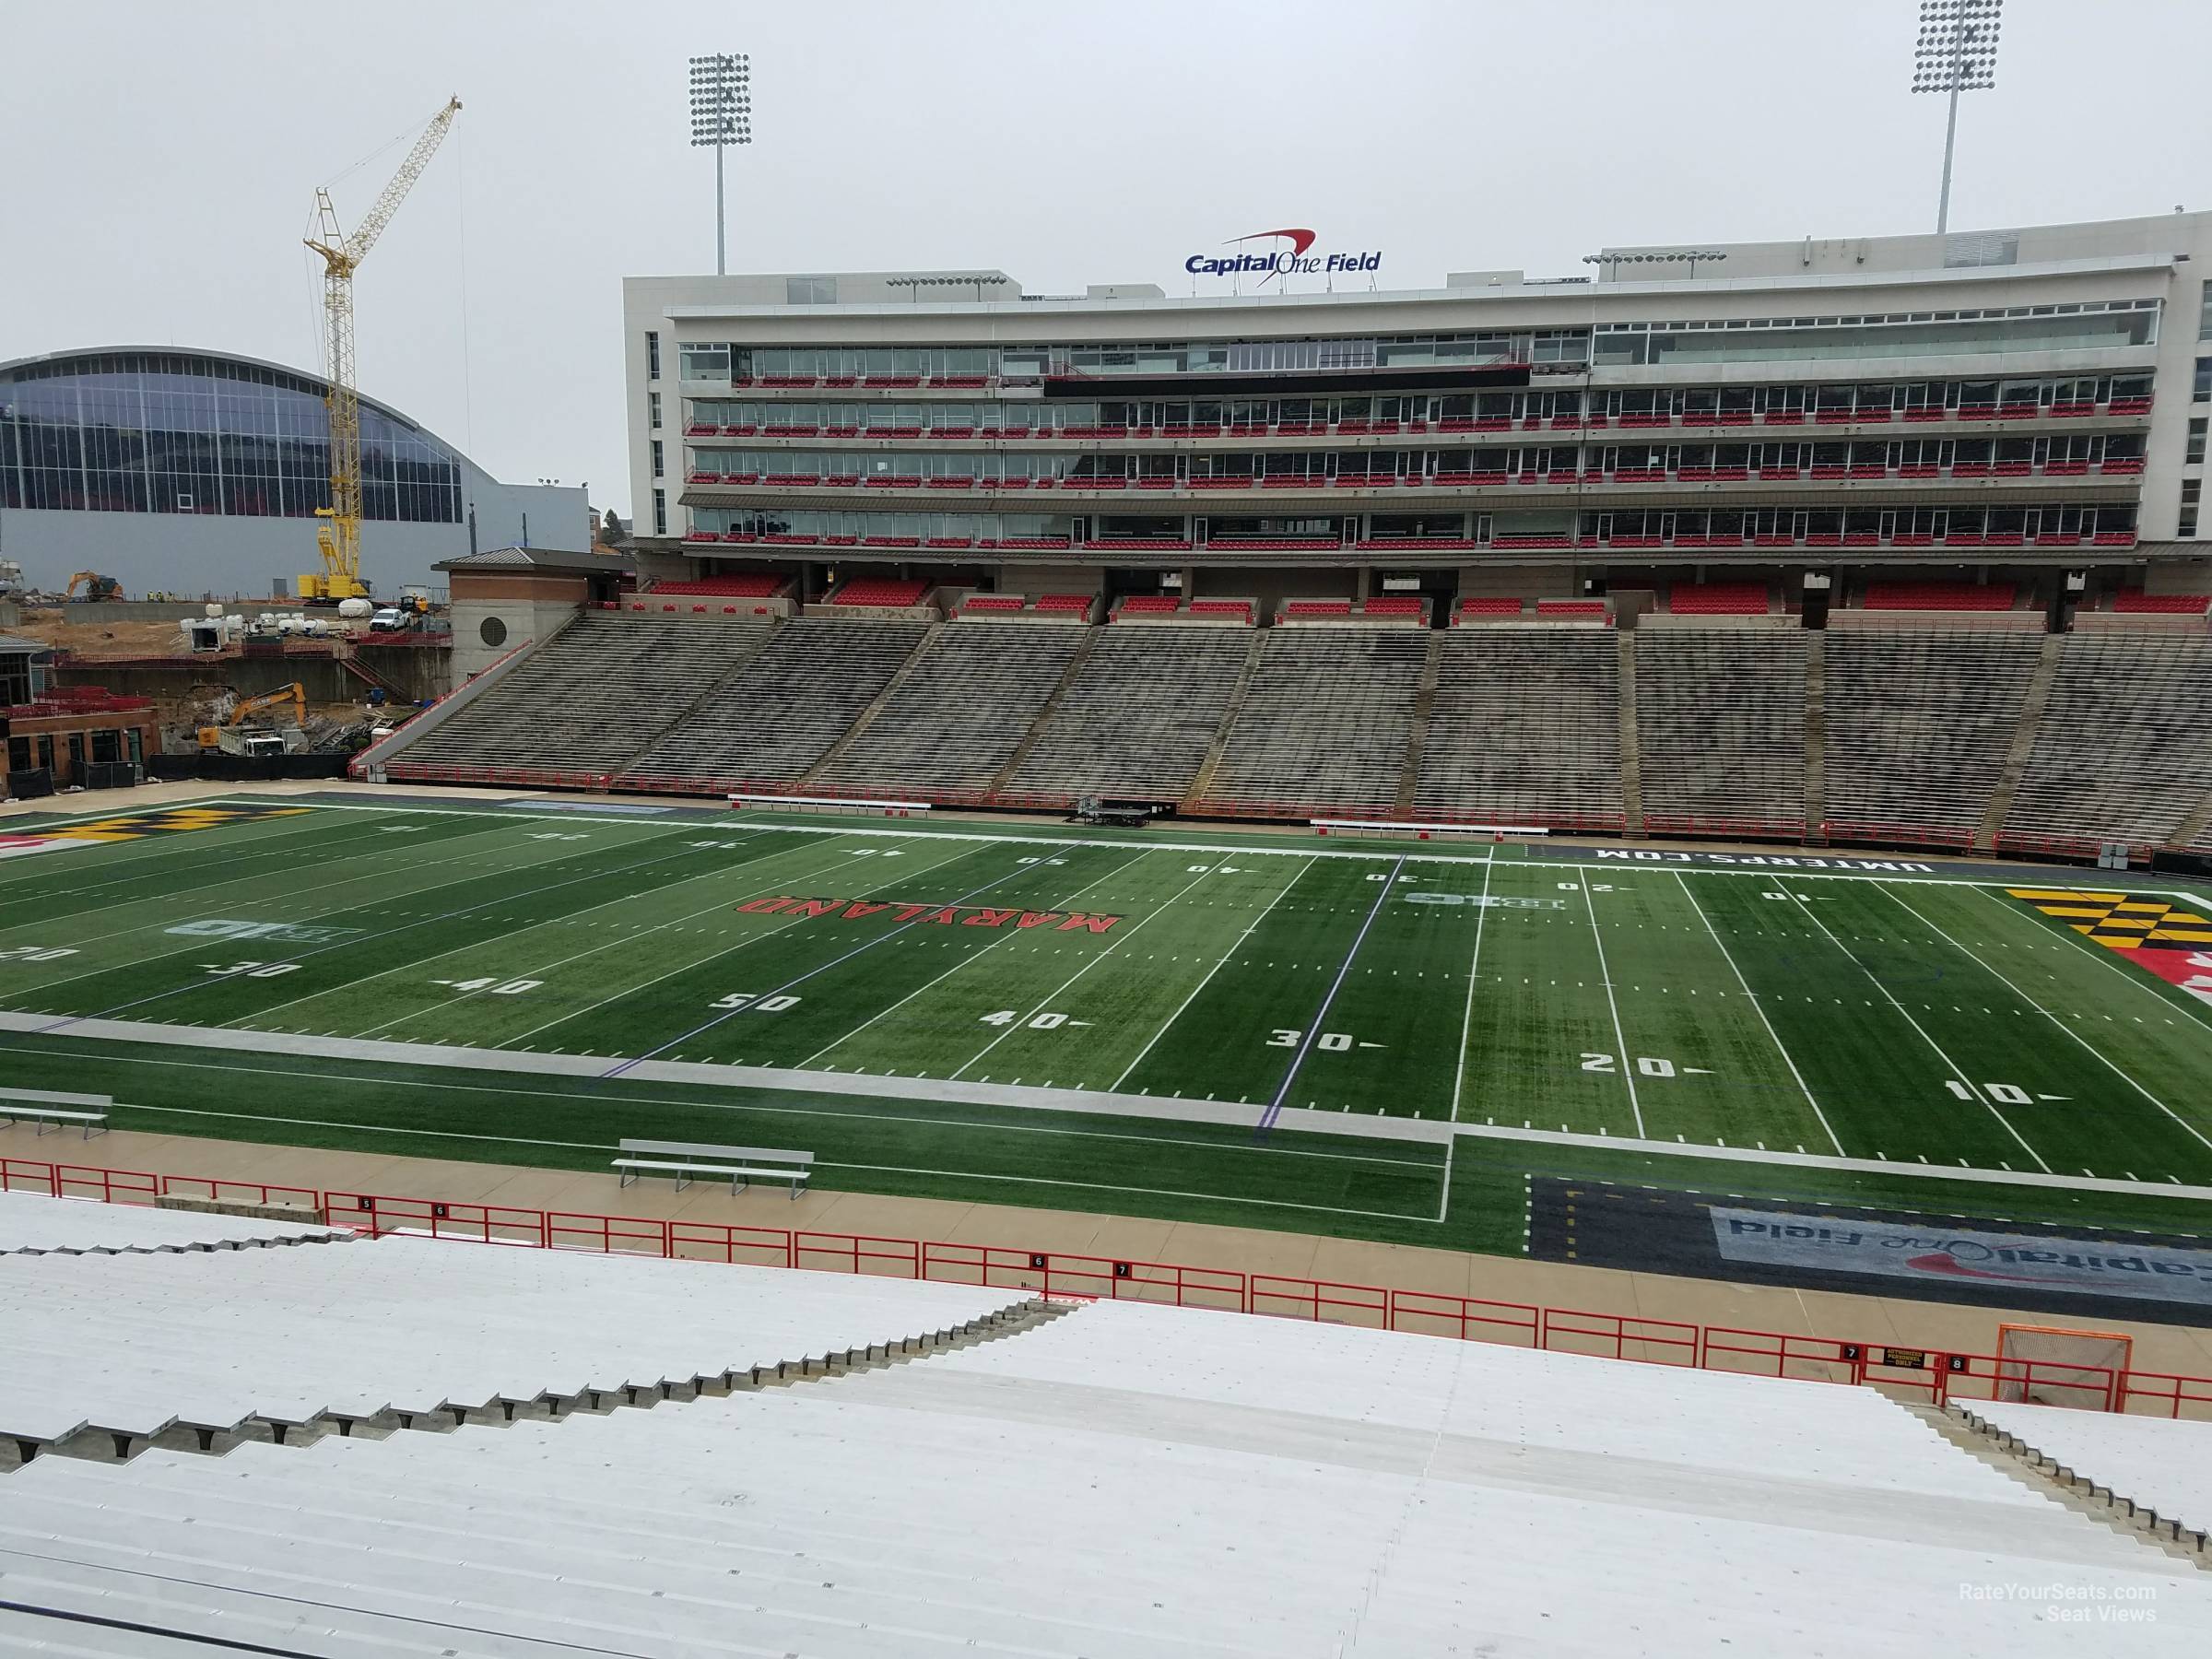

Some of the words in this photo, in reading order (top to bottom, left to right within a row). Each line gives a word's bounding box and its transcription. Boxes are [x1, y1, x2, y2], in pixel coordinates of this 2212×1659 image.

[1326, 251, 1382, 272] Field
[251, 698, 271, 707] CASE
[690, 841, 747, 849] 30
[851, 848, 907, 856] 40
[1016, 857, 1070, 866] 50
[1186, 865, 1241, 875] 40
[1594, 849, 1937, 873] UMTERPS.COM
[1366, 874, 1418, 883] 30
[1557, 882, 1614, 892] 20
[734, 897, 1124, 934] MARYLAND
[206, 961, 303, 978] 30
[451, 977, 545, 995] 40
[707, 993, 803, 1012] 50
[978, 1010, 1070, 1030] 40
[1265, 1029, 1354, 1052] 30
[1580, 1053, 1676, 1077] 20
[1945, 1080, 2034, 1105] 10
[1730, 1218, 1862, 1246] Field
[1895, 1359, 1912, 1367] ONLY
